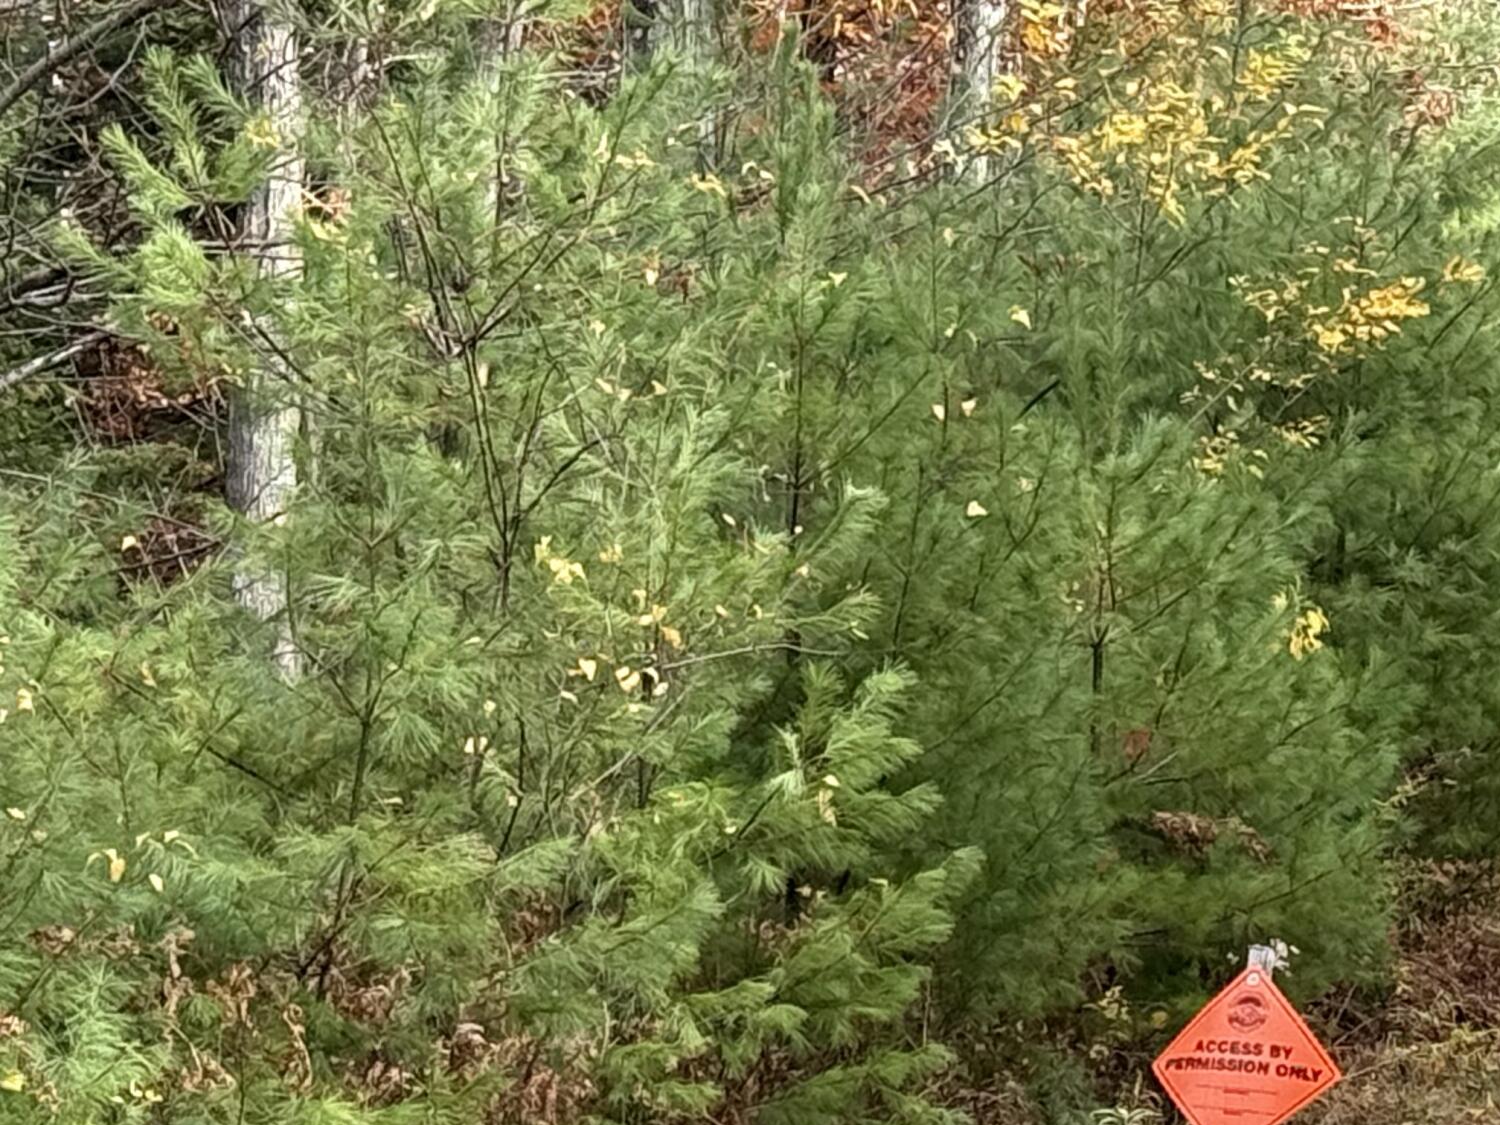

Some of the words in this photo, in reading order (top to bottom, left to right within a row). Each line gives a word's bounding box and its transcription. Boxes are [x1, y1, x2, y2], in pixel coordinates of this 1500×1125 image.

[1194, 1039, 1264, 1057] ACCESS
[1269, 1045, 1294, 1060] BY
[1164, 1056, 1271, 1076] PERMISSION
[1275, 1064, 1324, 1083] ONLY
